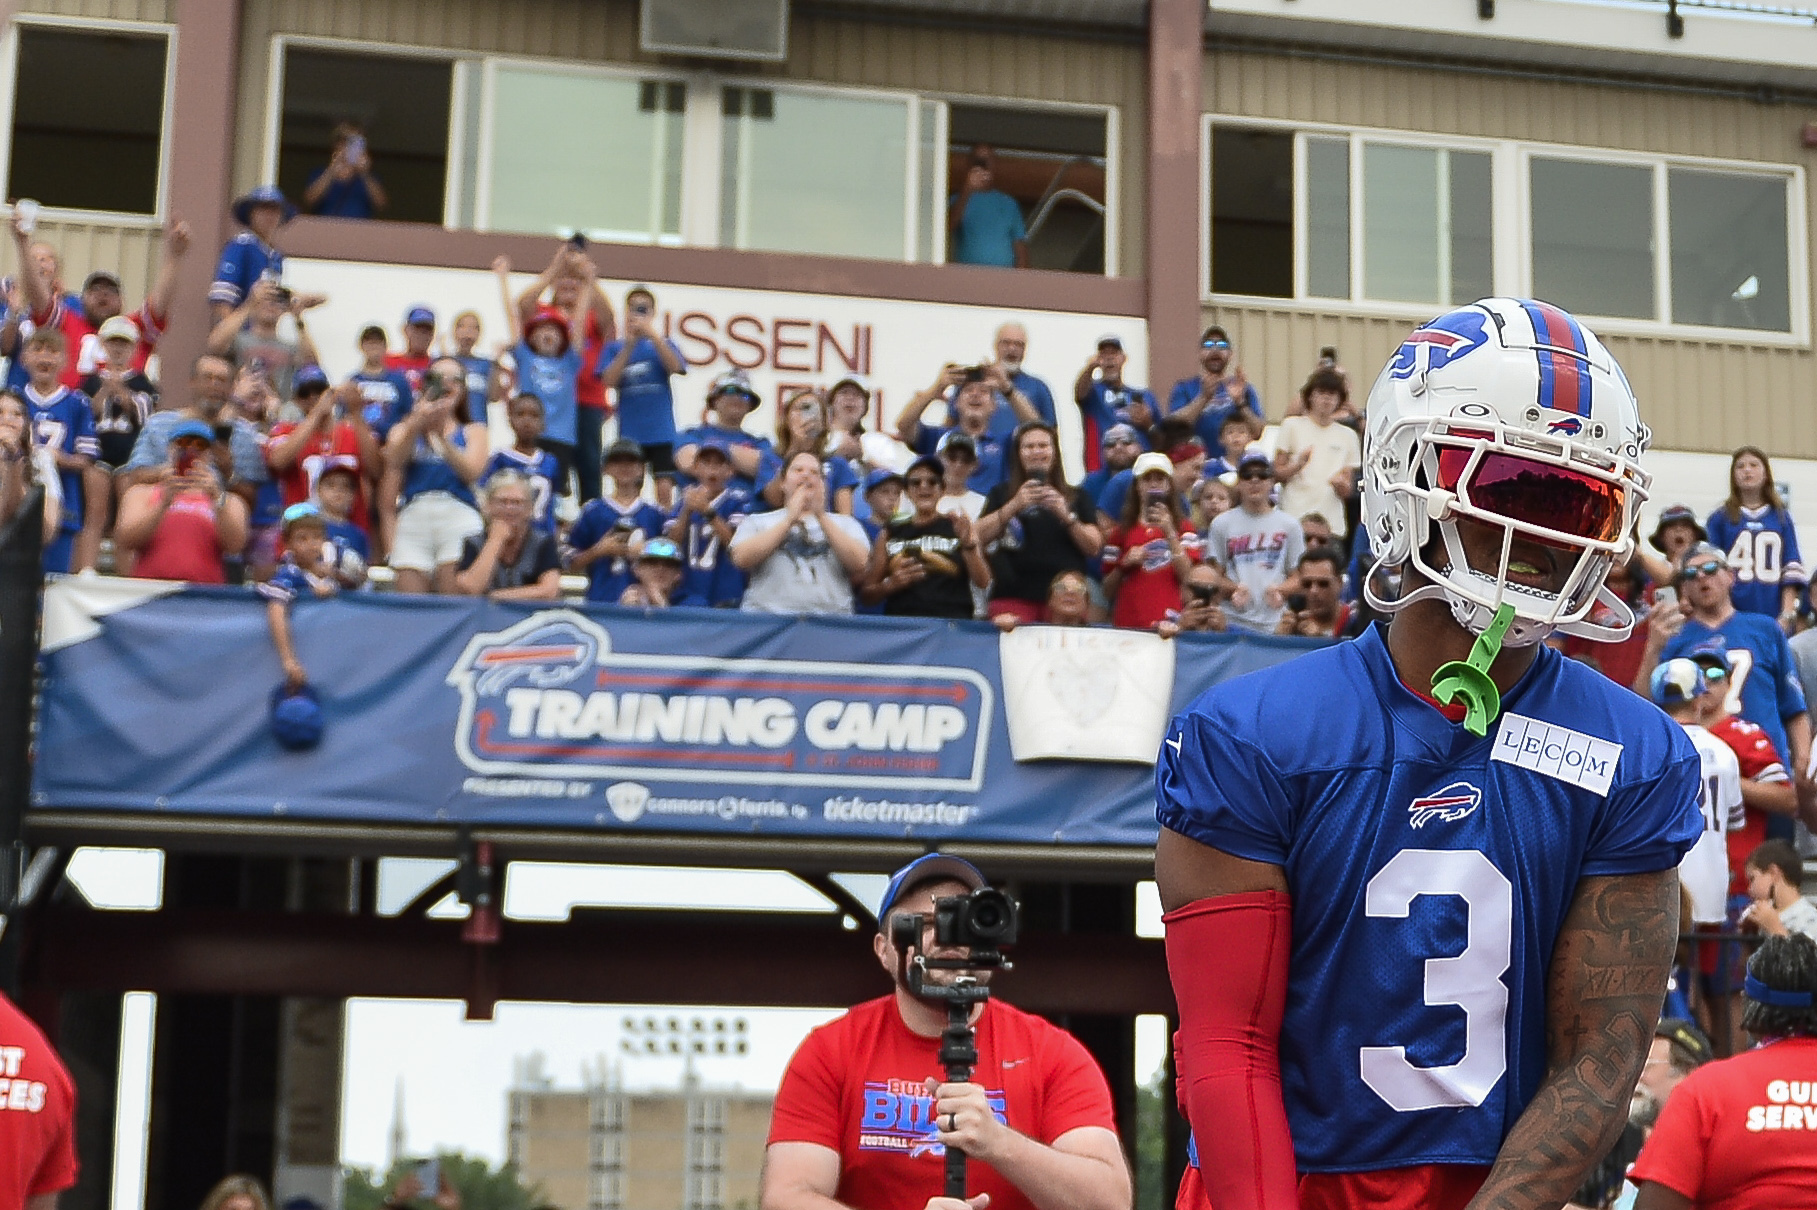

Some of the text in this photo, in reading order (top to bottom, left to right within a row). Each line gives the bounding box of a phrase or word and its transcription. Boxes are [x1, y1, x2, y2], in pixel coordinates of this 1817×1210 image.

[1727, 530, 1783, 583] 40
[506, 687, 968, 752] TRAINING CAMP
[1501, 731, 1609, 778] LECOM
[823, 796, 972, 826] ticketmaster
[1360, 849, 1512, 1112] 3
[860, 1135, 908, 1148] FOOTBALL
